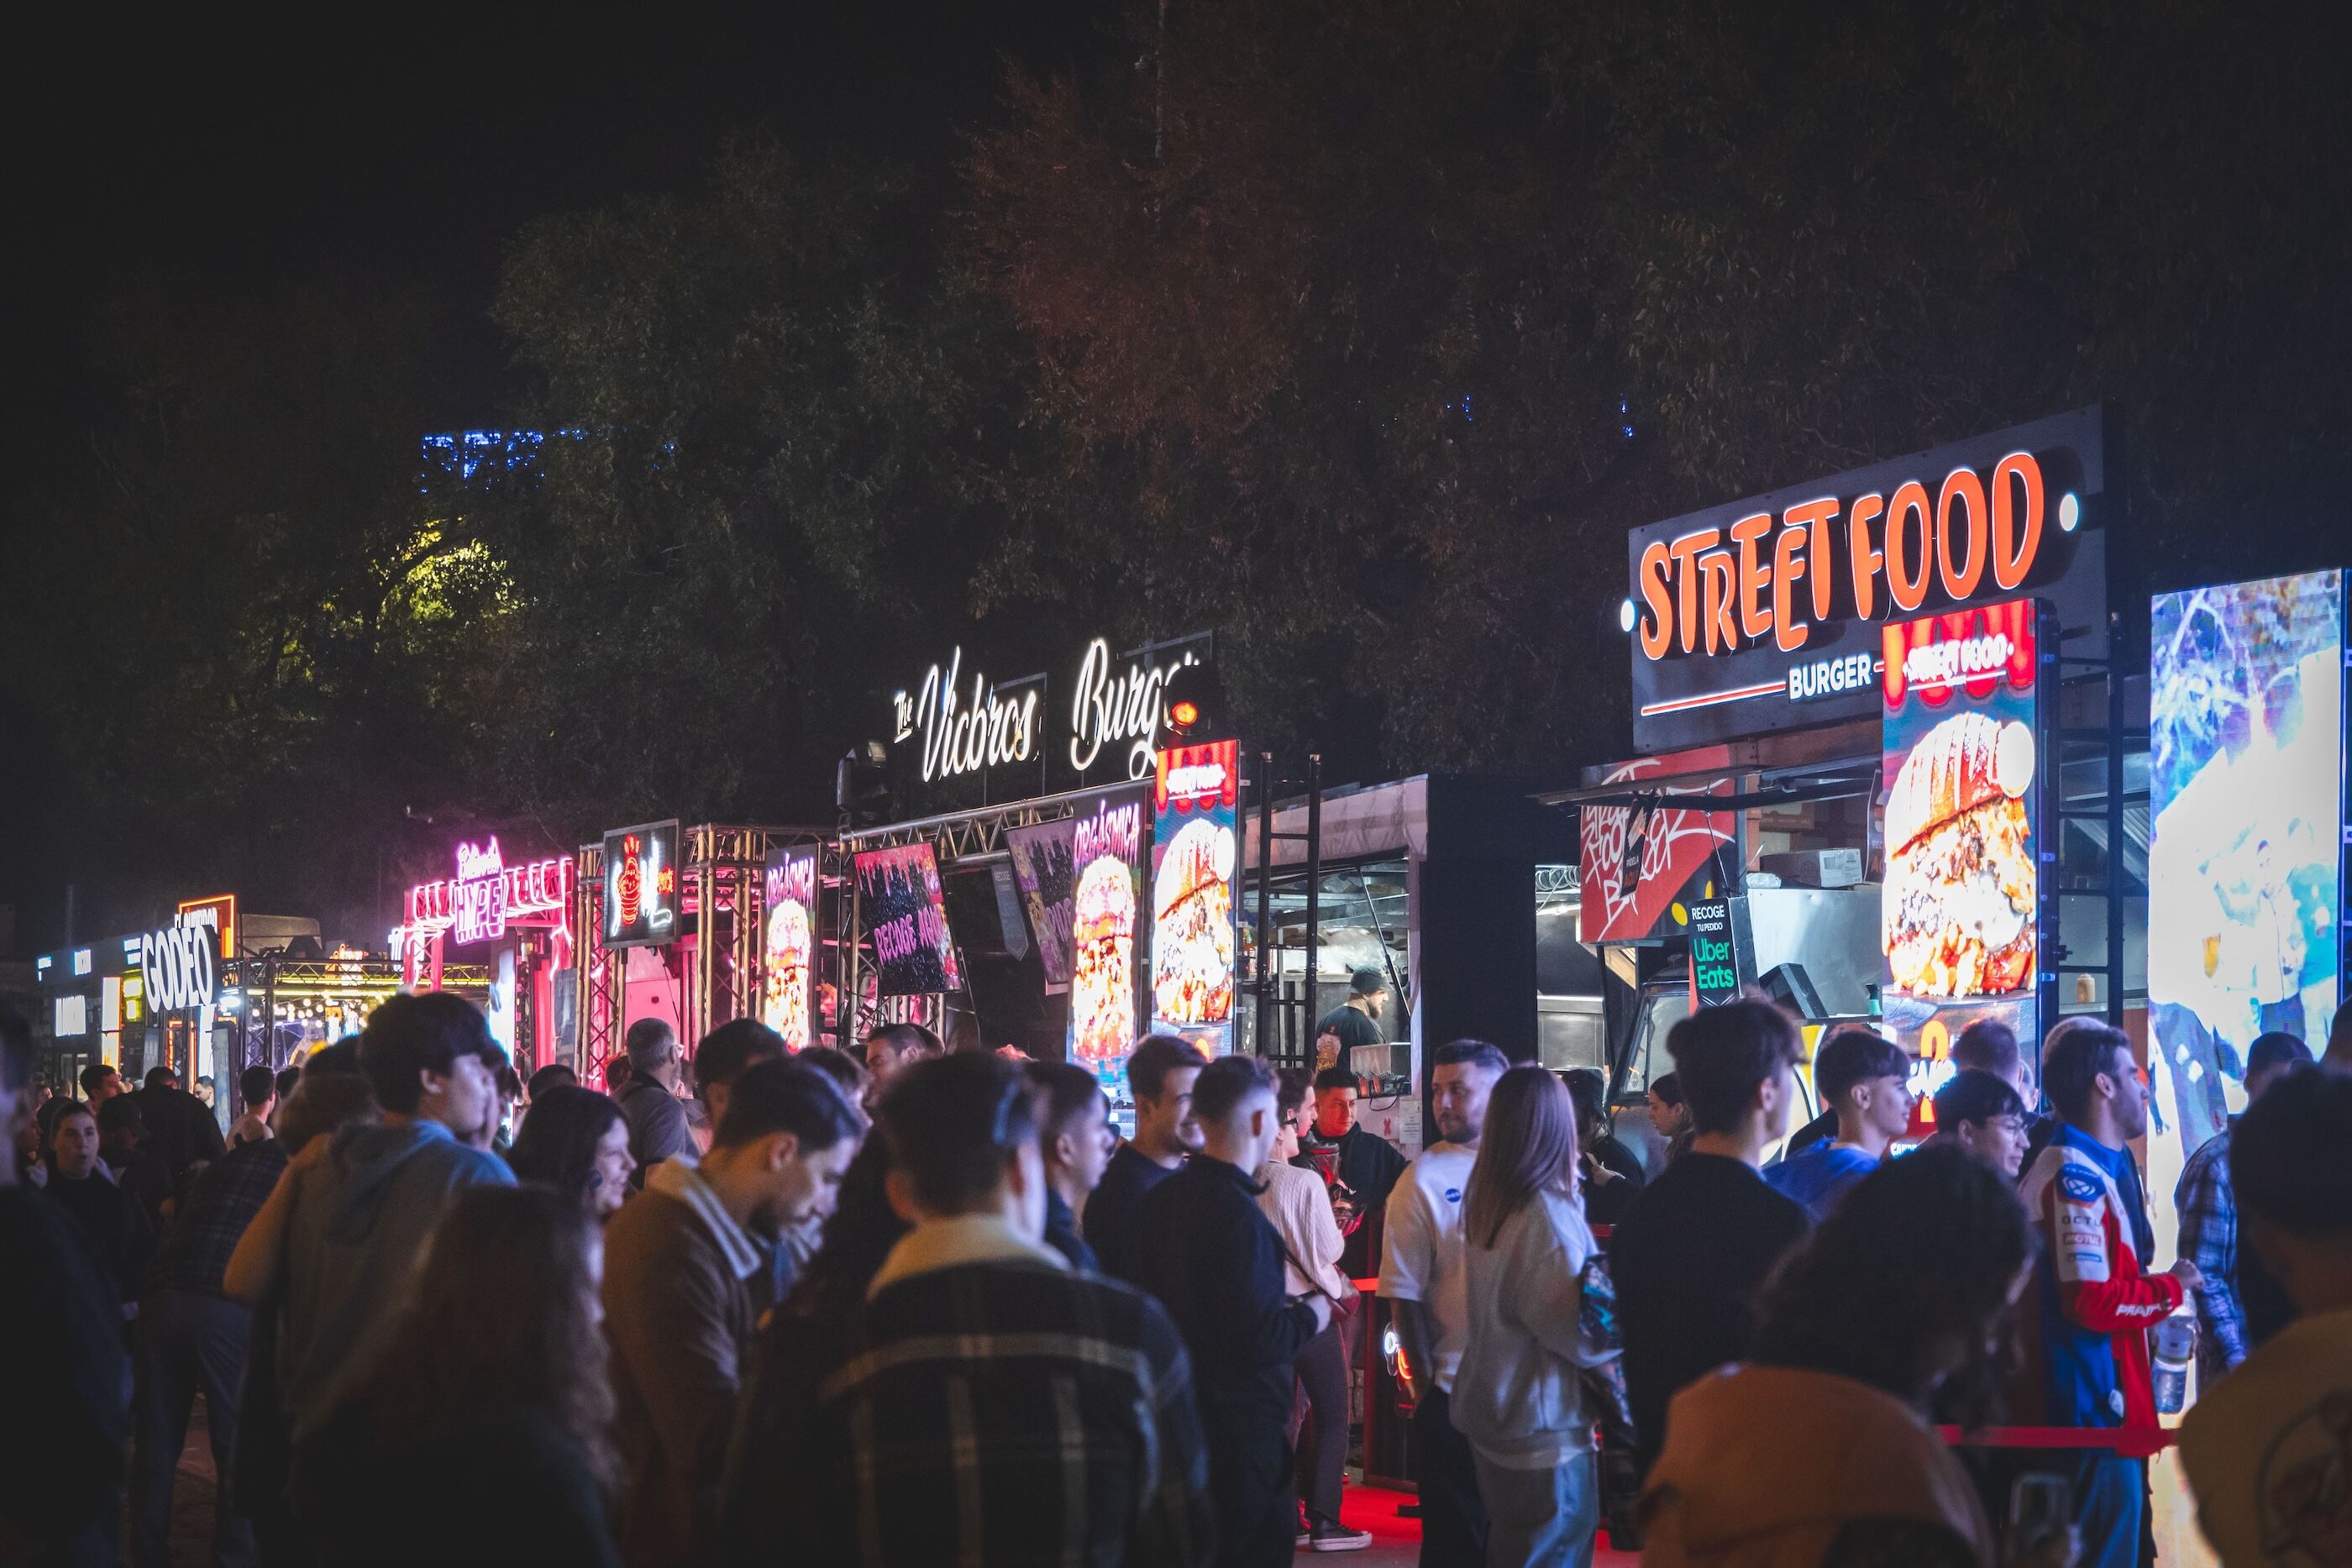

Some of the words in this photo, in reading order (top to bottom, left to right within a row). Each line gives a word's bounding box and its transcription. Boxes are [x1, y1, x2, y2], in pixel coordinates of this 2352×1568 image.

[1640, 497, 1840, 661] STREET
[1850, 452, 2045, 621] FOOD
[1789, 654, 1871, 700] BURGER
[894, 690, 915, 742] The
[1071, 637, 1200, 781] Burg
[454, 876, 509, 944] HYPE!
[1691, 905, 1725, 920] RECOGE
[1697, 924, 1704, 932] TU
[1704, 922, 1723, 931] PEDIDO
[874, 913, 917, 967] RECOGE
[1693, 938, 1730, 962] Uber
[142, 925, 213, 1013] GODEO
[1697, 965, 1735, 989] Eats
[2065, 1234, 2101, 1245] MOTUL
